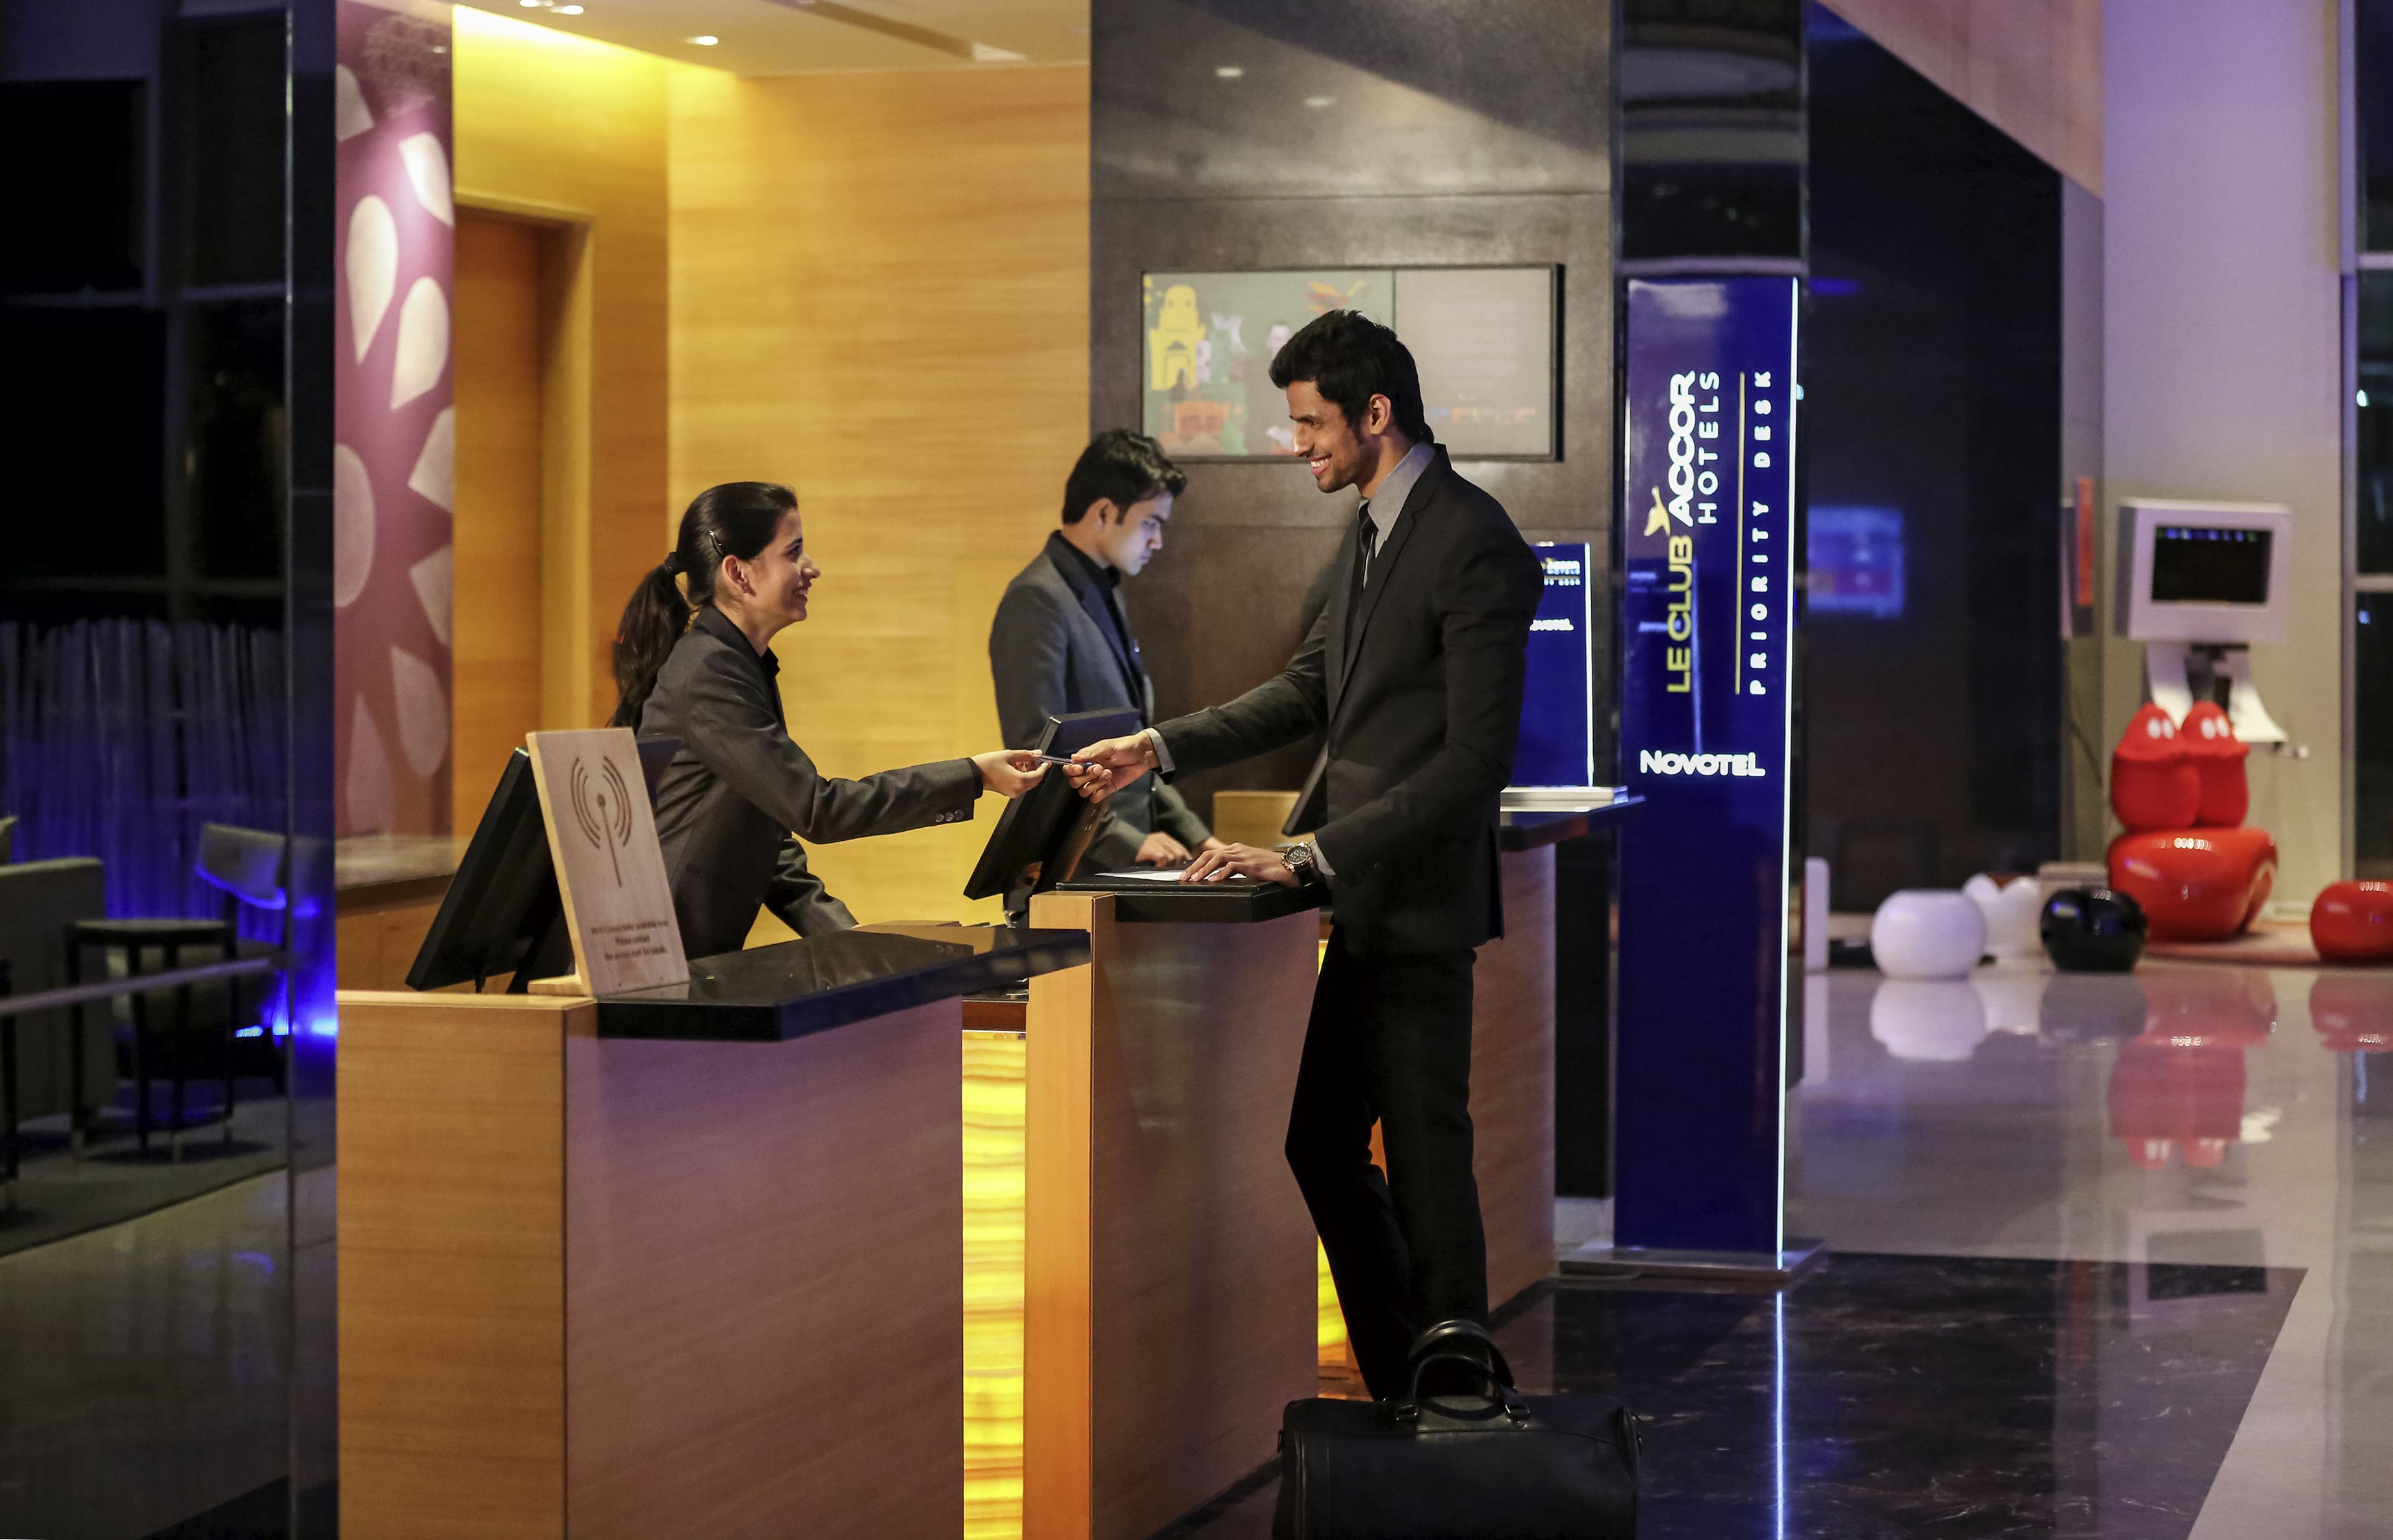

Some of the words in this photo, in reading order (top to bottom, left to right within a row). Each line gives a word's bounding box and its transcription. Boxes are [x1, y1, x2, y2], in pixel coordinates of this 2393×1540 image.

[1668, 370, 1695, 527] ACCOR
[1697, 372, 1719, 524] HOTELS
[1754, 371, 1771, 468] DESK
[1667, 535, 1693, 641] CLUB
[1749, 500, 1769, 695] PRIORITY
[1667, 647, 1691, 692] LE
[1640, 749, 1766, 776] NOVOTEL
